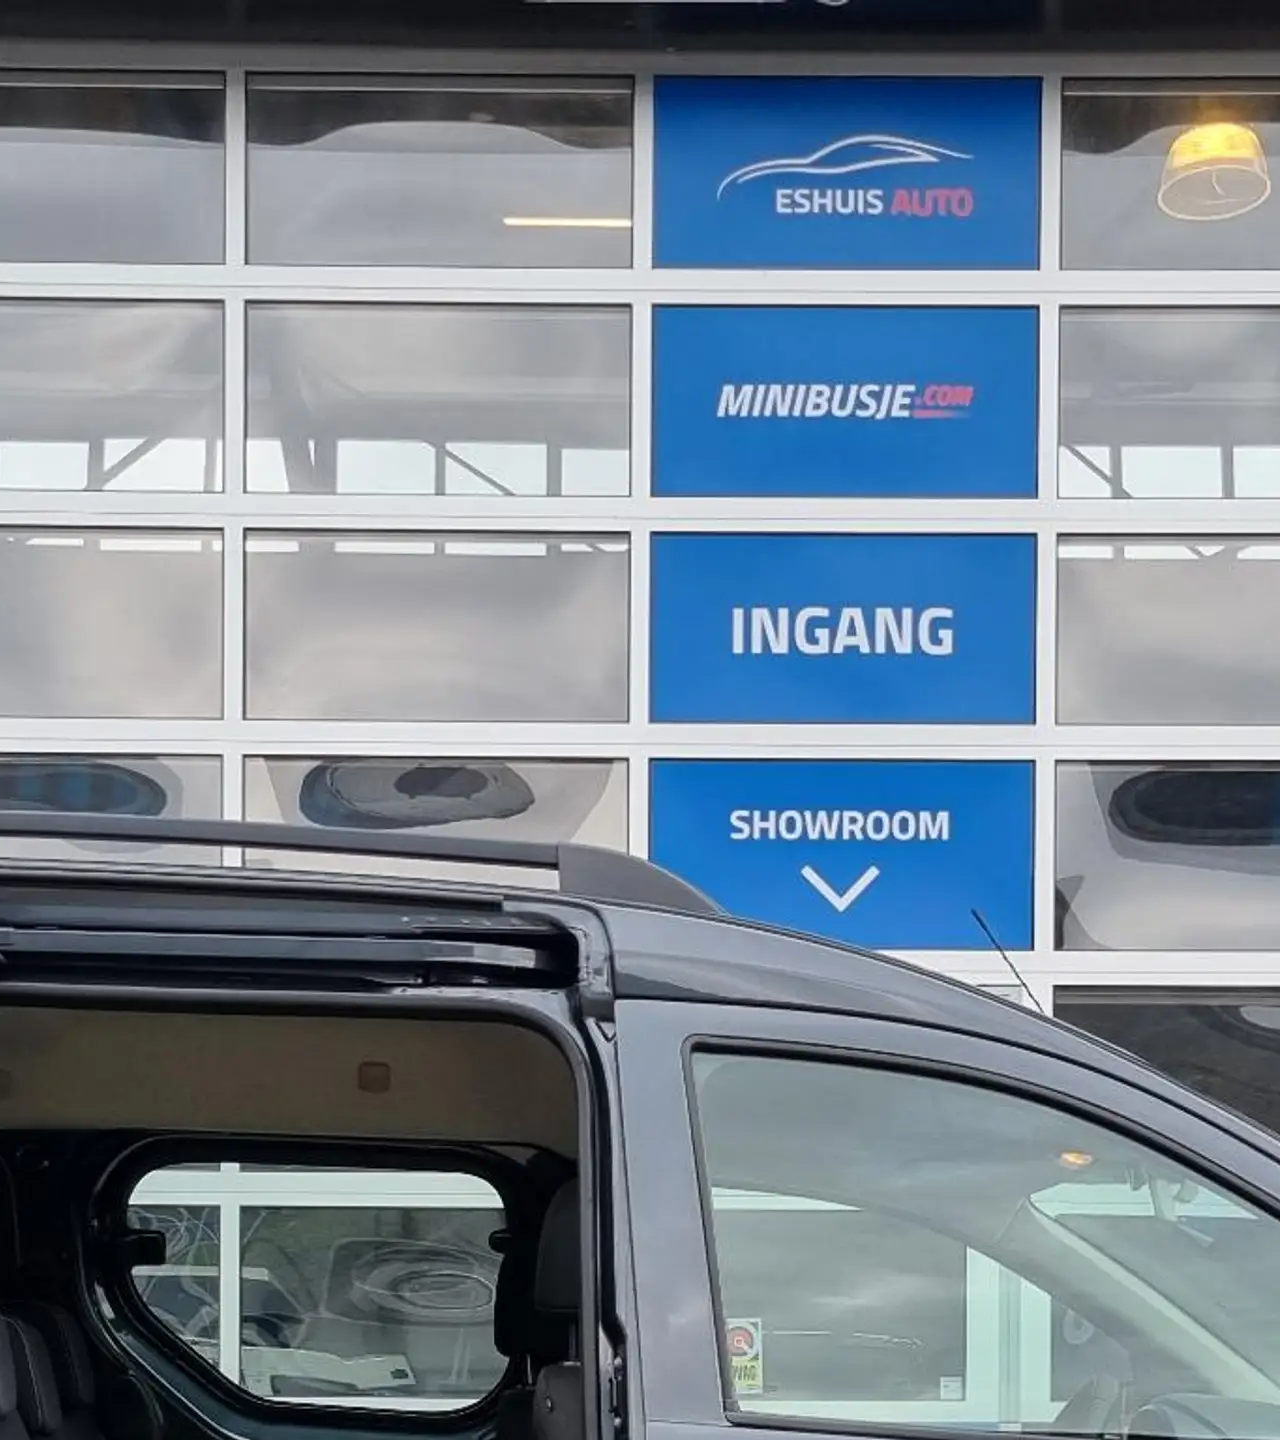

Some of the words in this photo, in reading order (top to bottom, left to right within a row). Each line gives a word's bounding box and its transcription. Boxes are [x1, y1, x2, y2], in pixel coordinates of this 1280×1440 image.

[775, 188, 884, 215] ESHUIS
[890, 187, 974, 217] AUTO
[731, 606, 954, 656] INGANG
[729, 809, 950, 841] SHOWROOM
